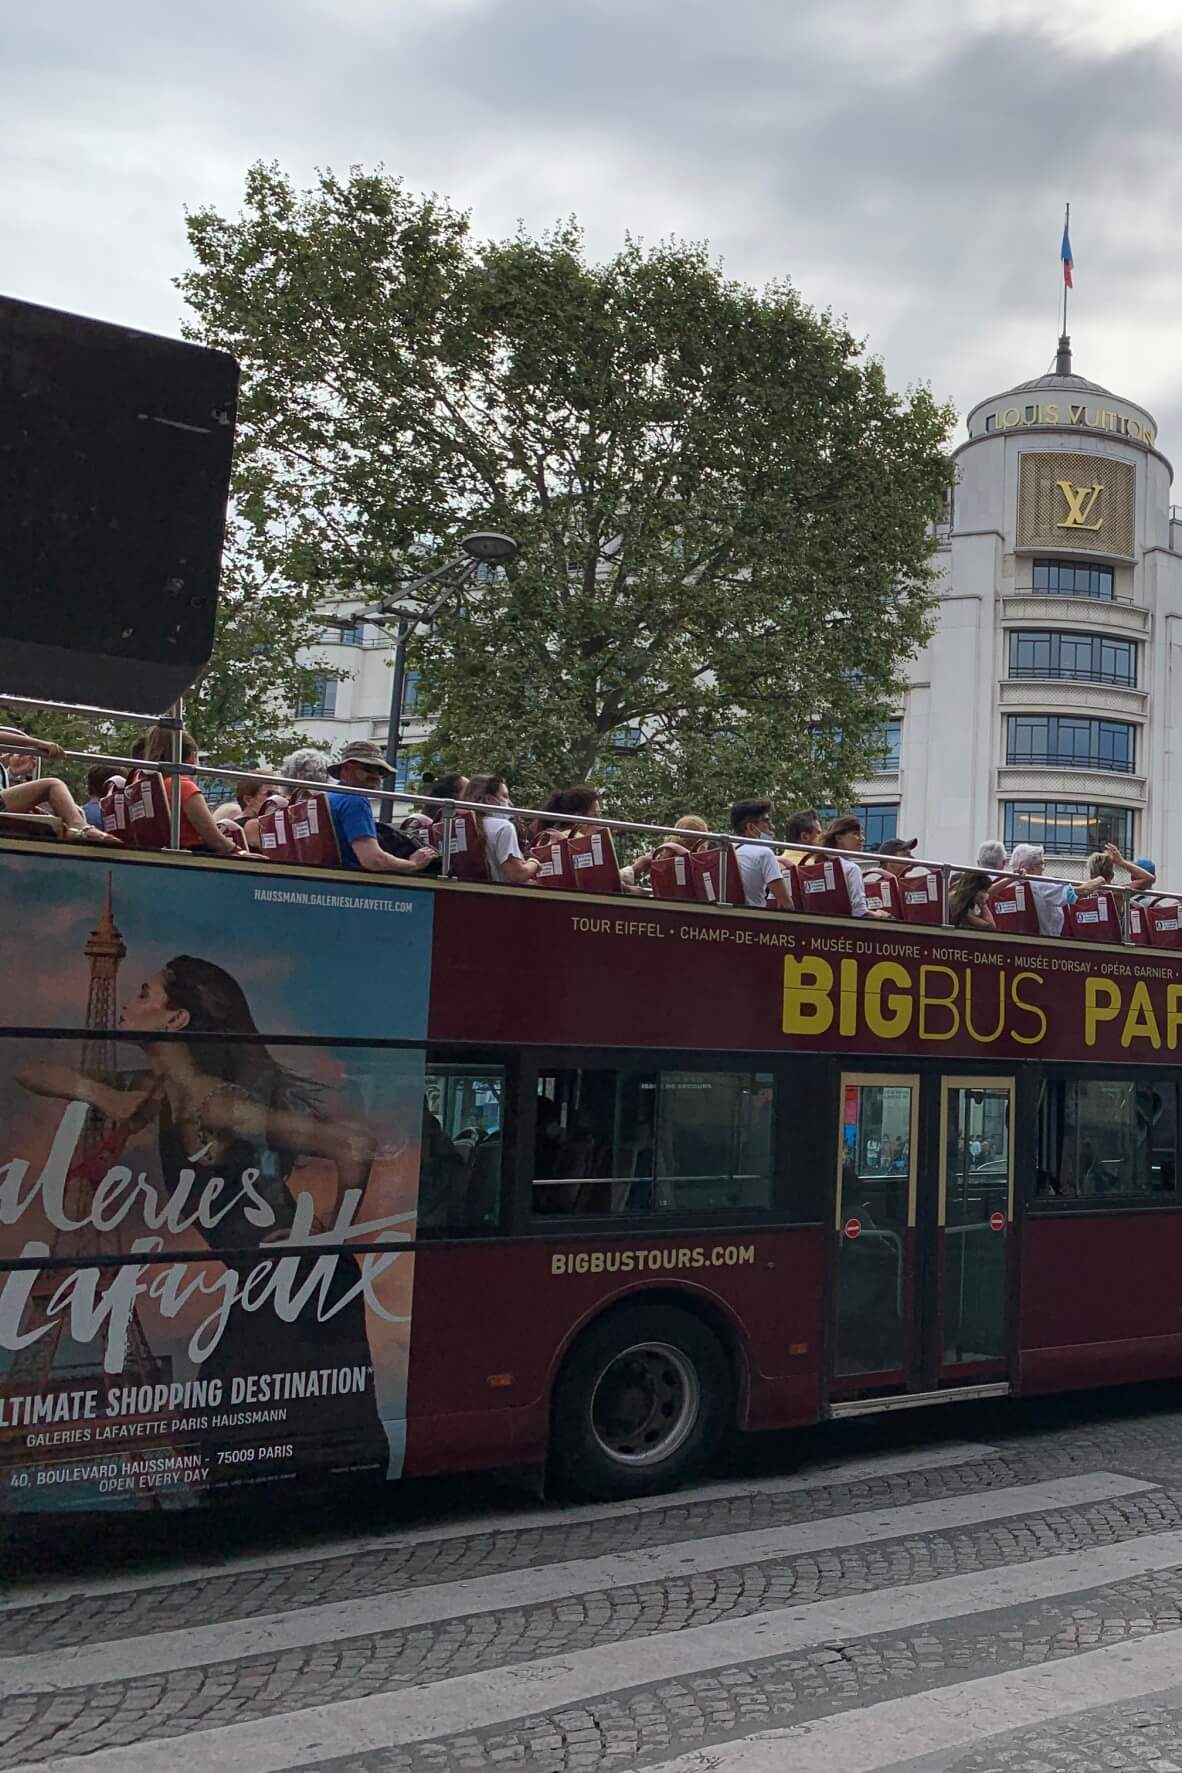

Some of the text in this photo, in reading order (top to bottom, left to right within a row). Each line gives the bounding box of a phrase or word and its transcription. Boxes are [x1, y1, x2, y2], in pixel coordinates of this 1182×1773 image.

[995, 405, 1154, 444] LOUIS VUITTON
[254, 889, 413, 913] HAUSSMANN.GALERIESLAFAYETTE.COM
[571, 917, 611, 933] TOUR
[615, 921, 665, 938] EIFFEL
[680, 926, 796, 948] CHAMP-DE-MARS
[811, 938, 853, 953] MUSÉE
[857, 942, 874, 954] DU
[877, 944, 921, 958] LOUVRE
[932, 948, 1004, 966] NOTRE-DAME
[1014, 955, 1049, 970] MUSÉE
[1051, 957, 1092, 973] D'ORSAY
[1101, 961, 1132, 977] OPÉRA
[1134, 967, 1173, 980] GARNIER
[551, 1244, 755, 1275] BIGBUSTOURS.COM
[105, 1378, 223, 1417] SHOPPING
[26, 1408, 287, 1448] GALERIES LAFAYETTE PARIS HAUSSMANN
[37, 1464, 118, 1485] BOULEVARD
[121, 1455, 202, 1476] HAUSSMANN
[217, 1449, 255, 1465] 75009
[258, 1444, 293, 1461] PARIS
[99, 1477, 135, 1493] OPEN
[139, 1471, 180, 1489] EVERY
[184, 1468, 210, 1483] DAY
